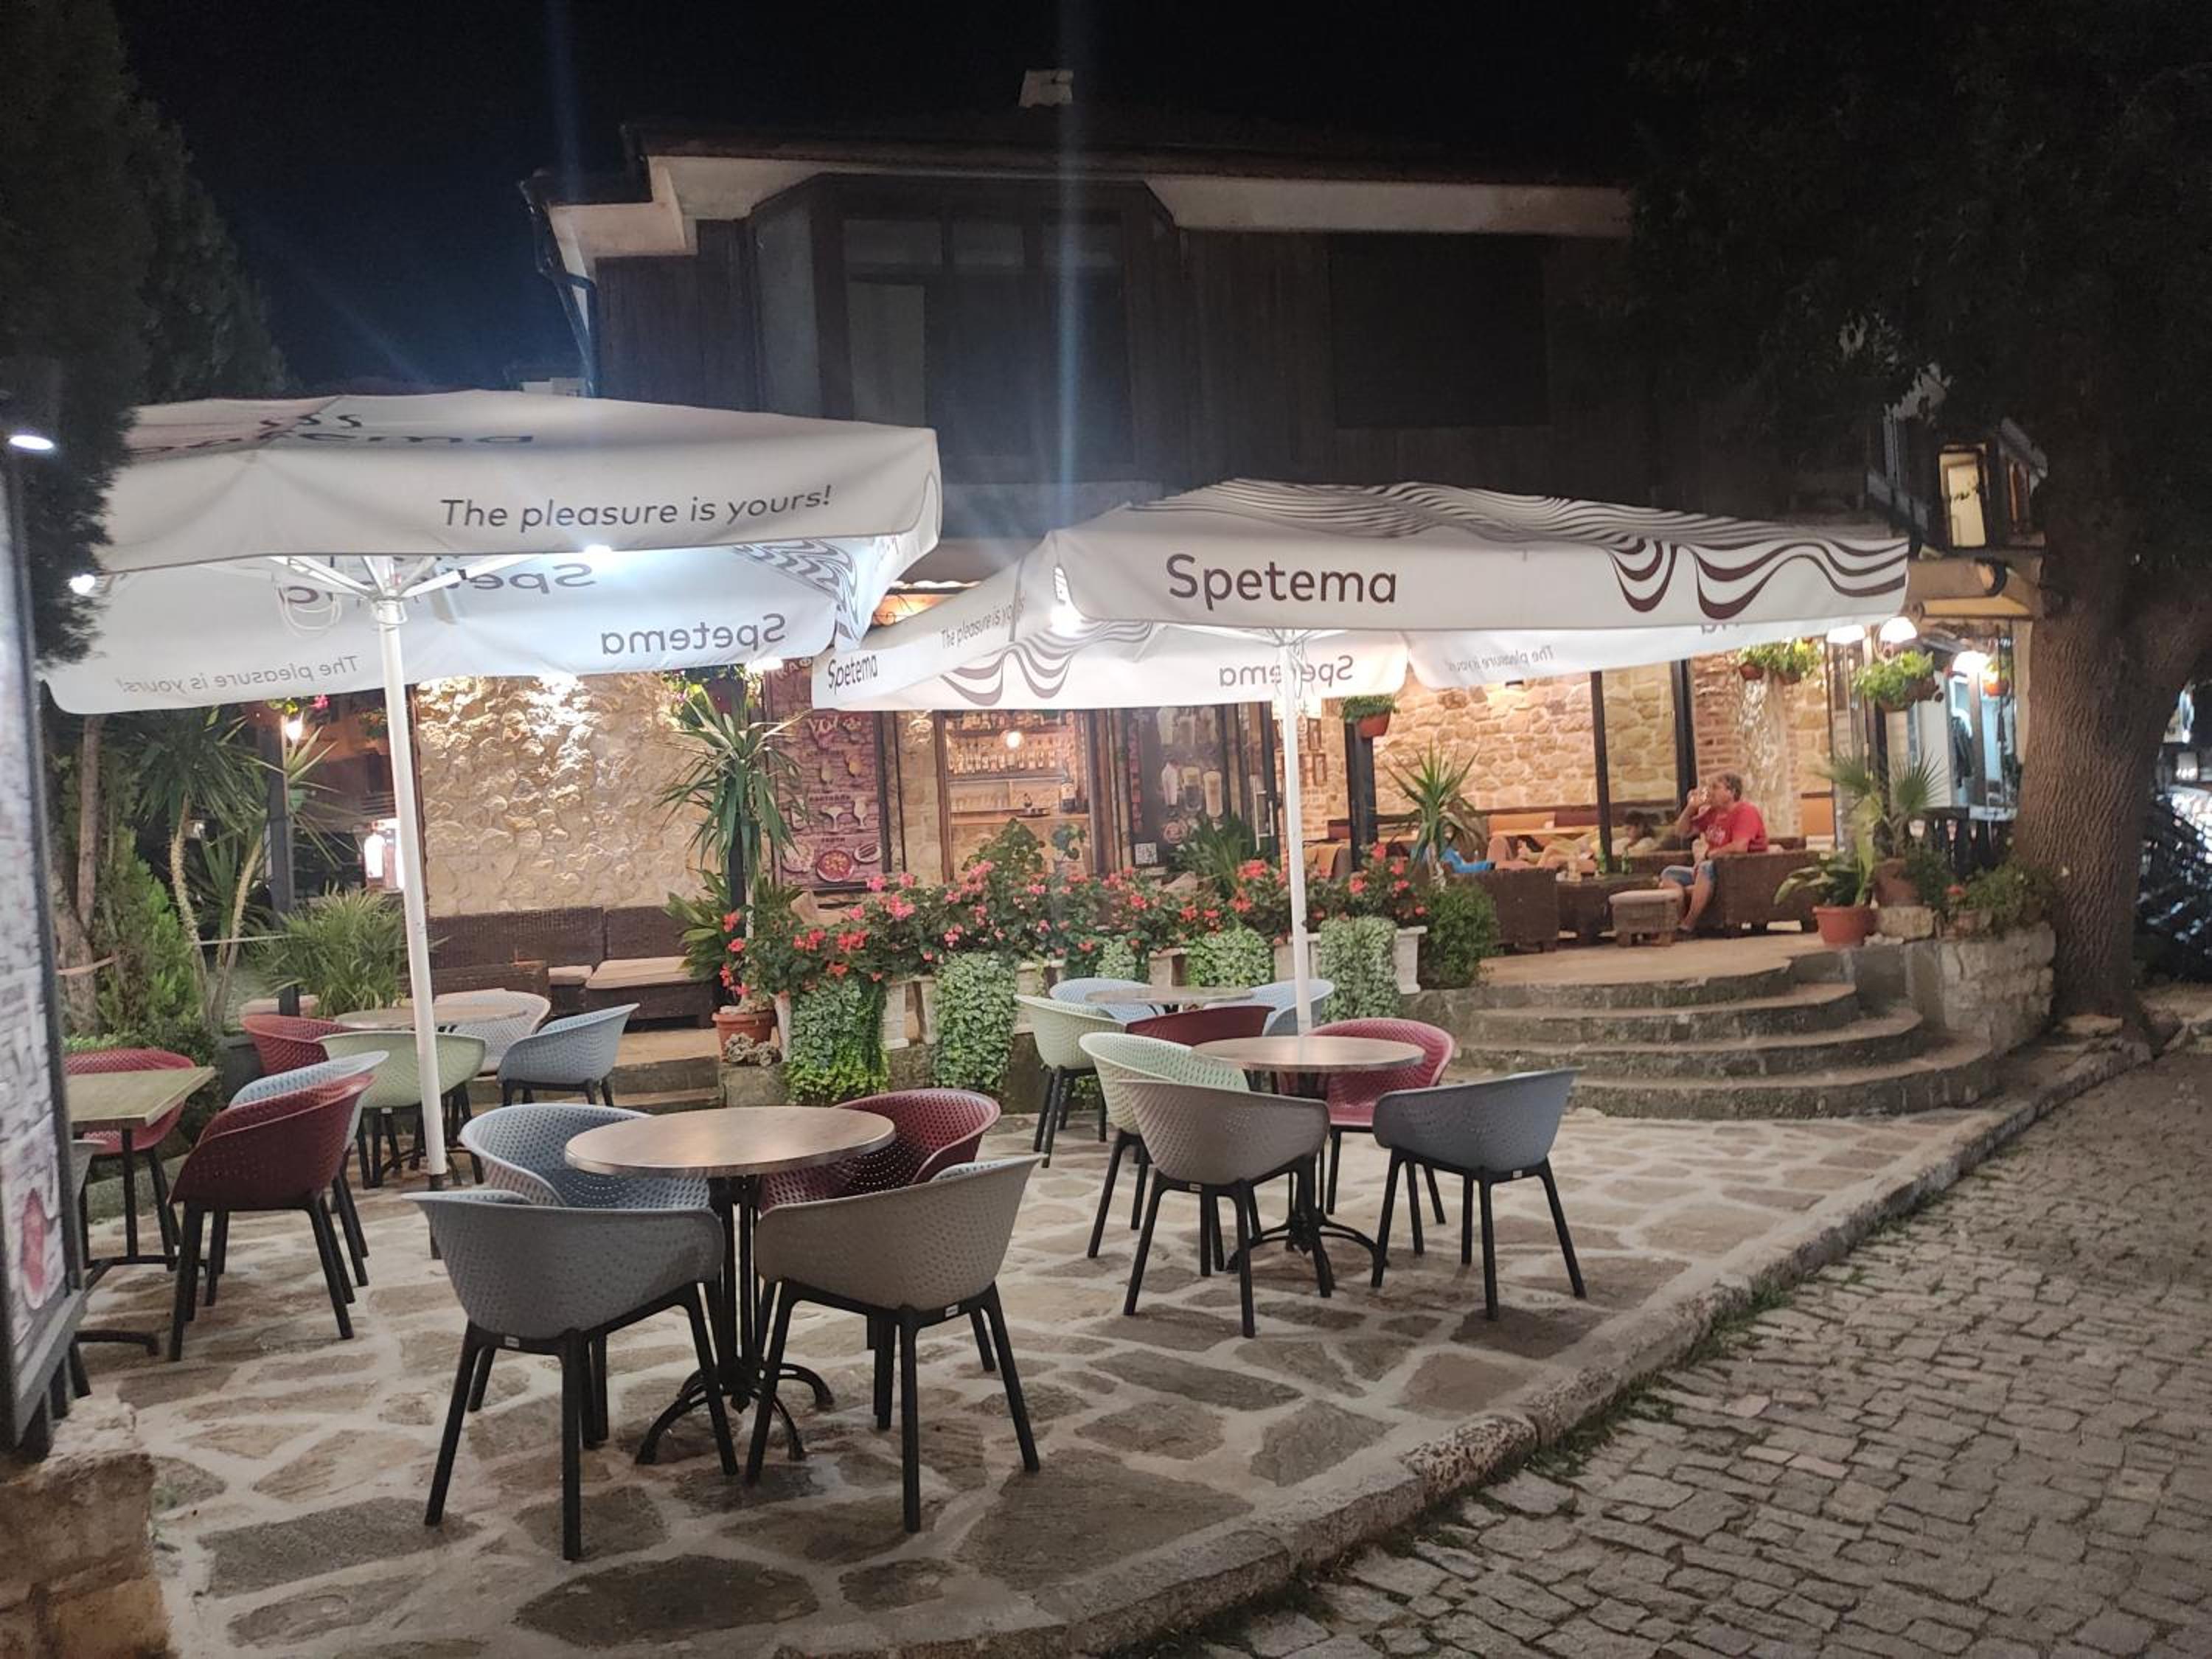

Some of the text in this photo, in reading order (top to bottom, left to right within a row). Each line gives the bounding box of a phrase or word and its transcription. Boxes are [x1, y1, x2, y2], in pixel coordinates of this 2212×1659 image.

[440, 484, 831, 533] The pleasure is yours!
[1166, 553, 1397, 611] Spetema
[828, 655, 878, 695] Spetema
